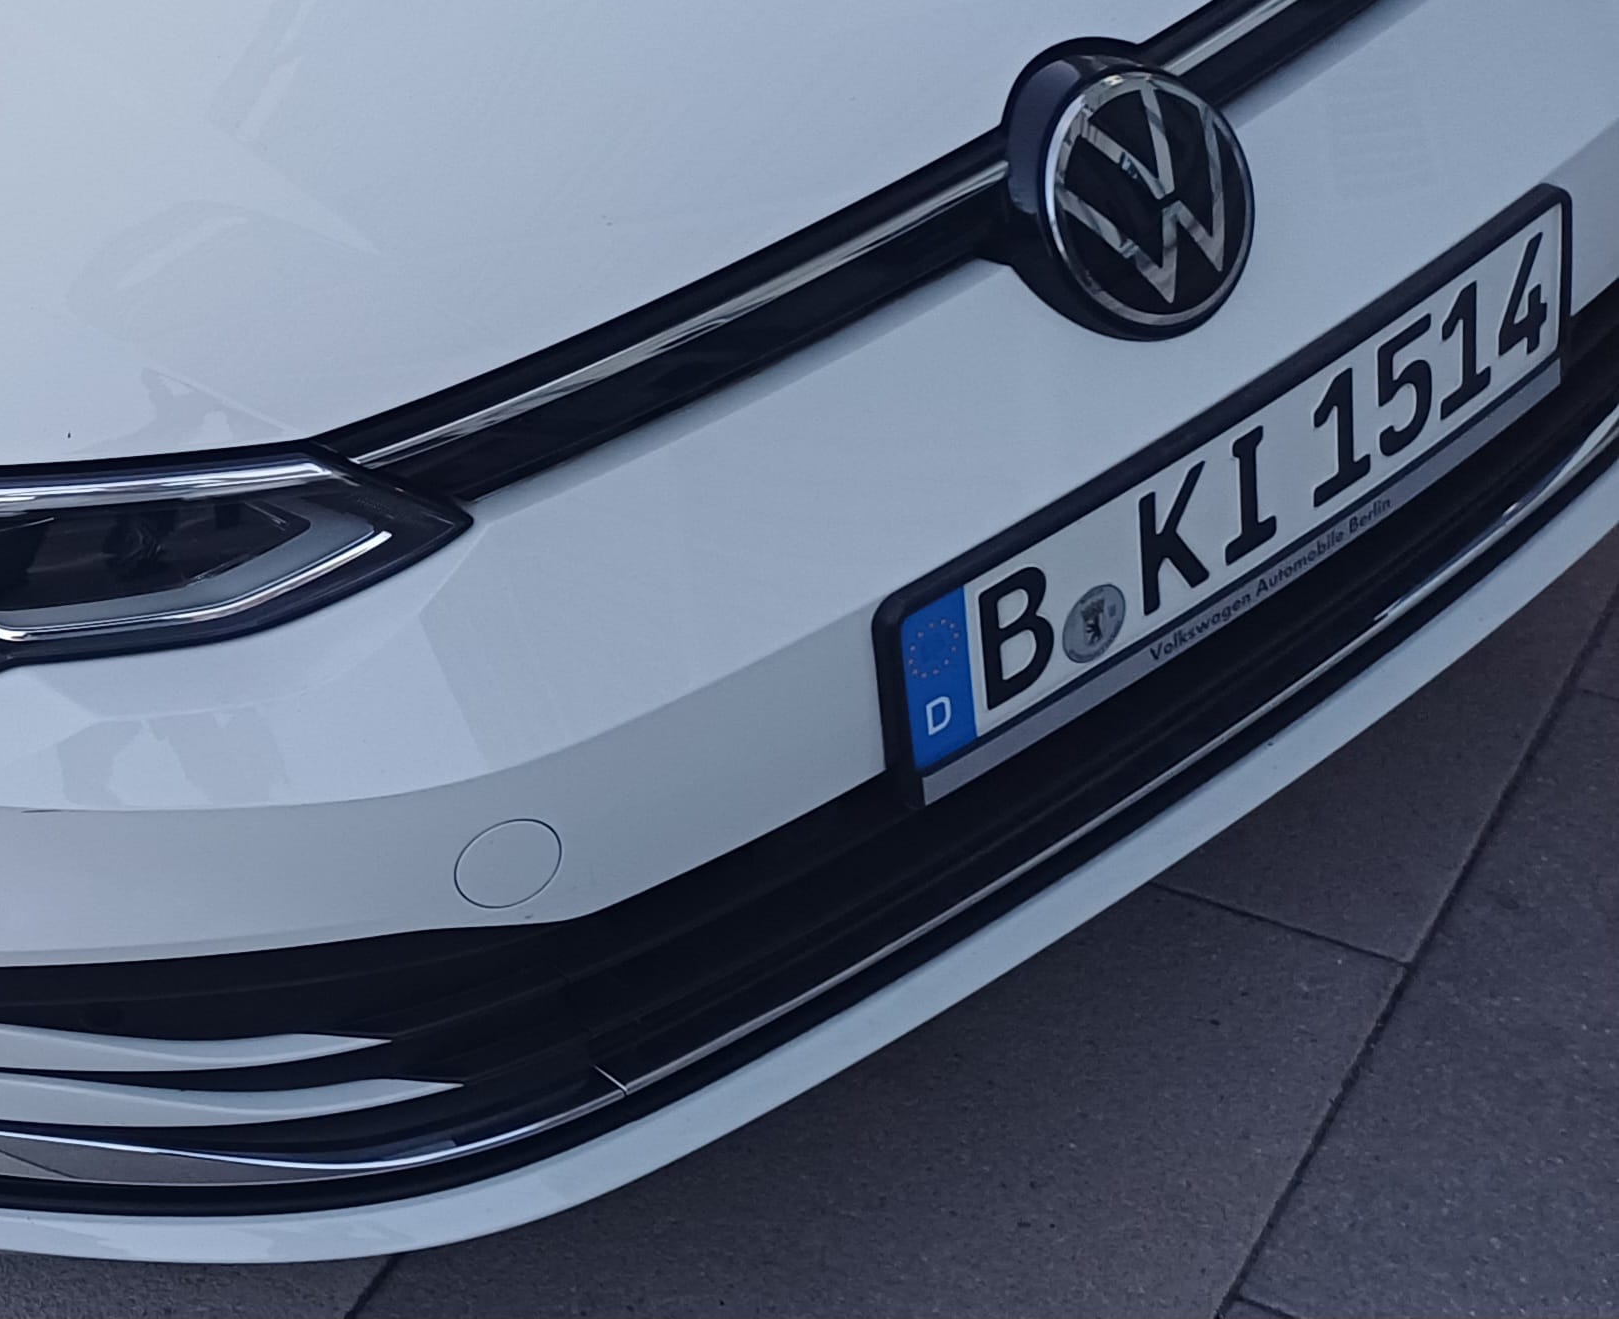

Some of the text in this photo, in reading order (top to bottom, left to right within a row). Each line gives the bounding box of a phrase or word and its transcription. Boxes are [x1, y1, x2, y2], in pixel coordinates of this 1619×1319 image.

[1056, 80, 1225, 304] VW
[979, 566, 1054, 710] B
[1138, 426, 1276, 616] KI
[1313, 231, 1548, 507] 1514
[1149, 594, 1252, 661] Volkswagen
[1255, 530, 1344, 597] Automobile
[1349, 497, 1392, 535] Berlin
[926, 695, 952, 735] D
